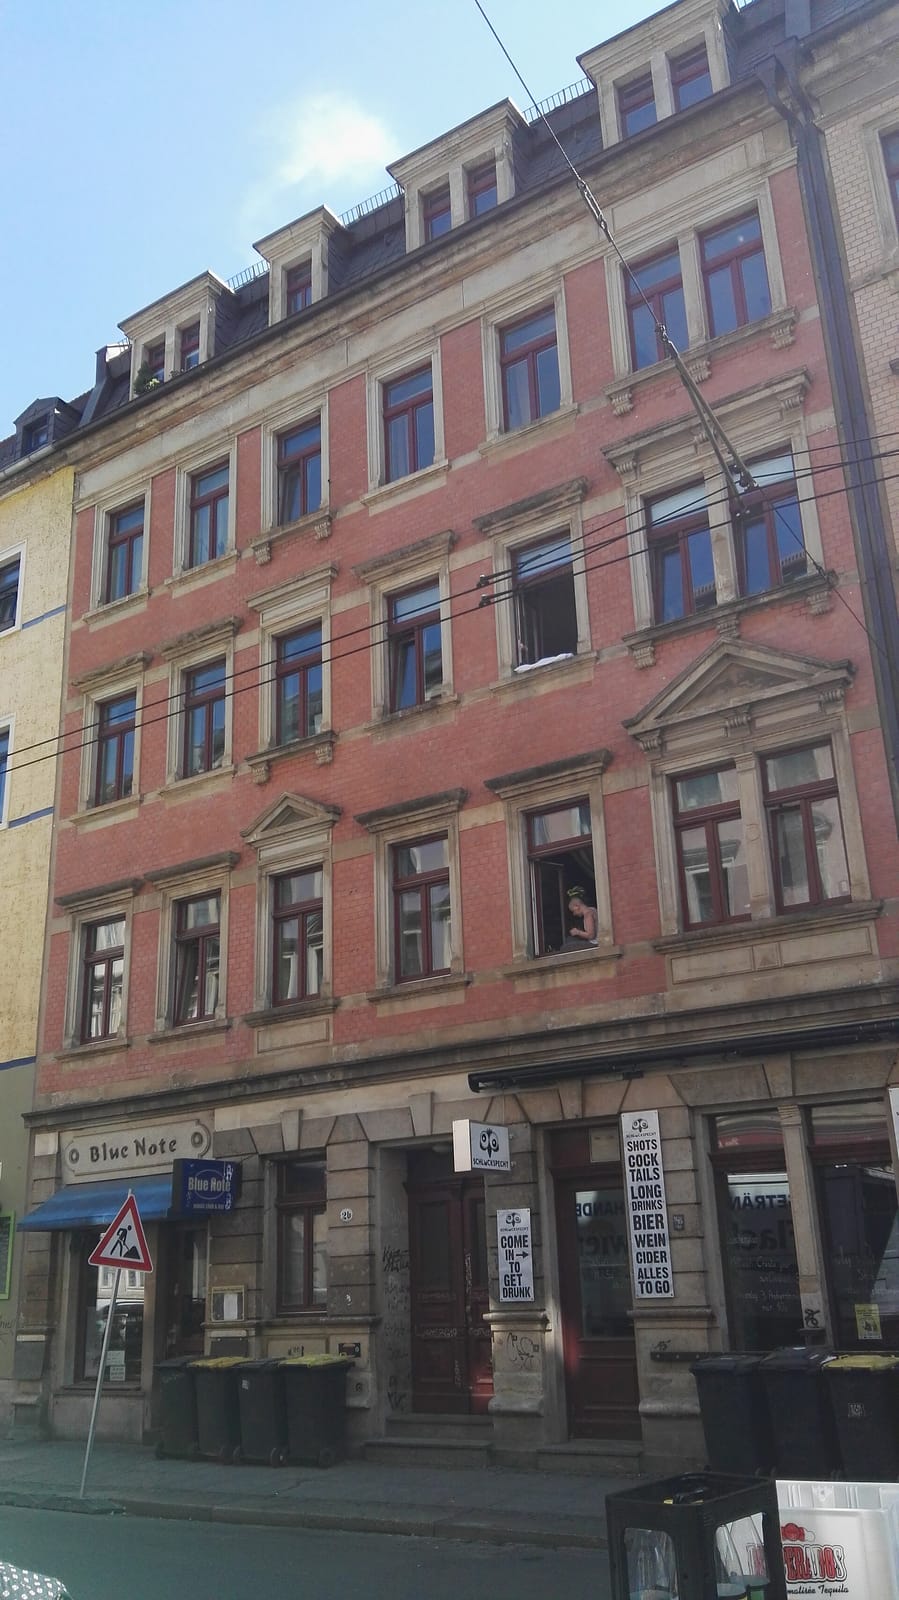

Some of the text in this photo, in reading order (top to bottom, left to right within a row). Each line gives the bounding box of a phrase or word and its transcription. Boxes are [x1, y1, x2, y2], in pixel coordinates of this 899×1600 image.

[90, 1137, 177, 1162] Blue Note
[627, 1139, 657, 1152] SHOTS
[473, 1158, 509, 1168] SCHLUCKSPECHT
[628, 1153, 659, 1168] COCK
[629, 1167, 660, 1182] TAILS
[188, 1177, 208, 1191] Blue
[630, 1184, 661, 1200] LONG
[632, 1199, 663, 1211] DRINKS
[632, 1213, 665, 1231] BIER
[500, 1235, 529, 1249] COME
[634, 1232, 666, 1248] WEIN
[505, 1250, 515, 1261] IN
[636, 1250, 668, 1264] CIDER
[509, 1262, 520, 1273] TO
[637, 1266, 669, 1280] ALLES
[503, 1274, 522, 1287] GET
[638, 1280, 670, 1295] TO GO
[502, 1287, 531, 1299] DRUNK
[818, 1583, 849, 1597] Tequila
